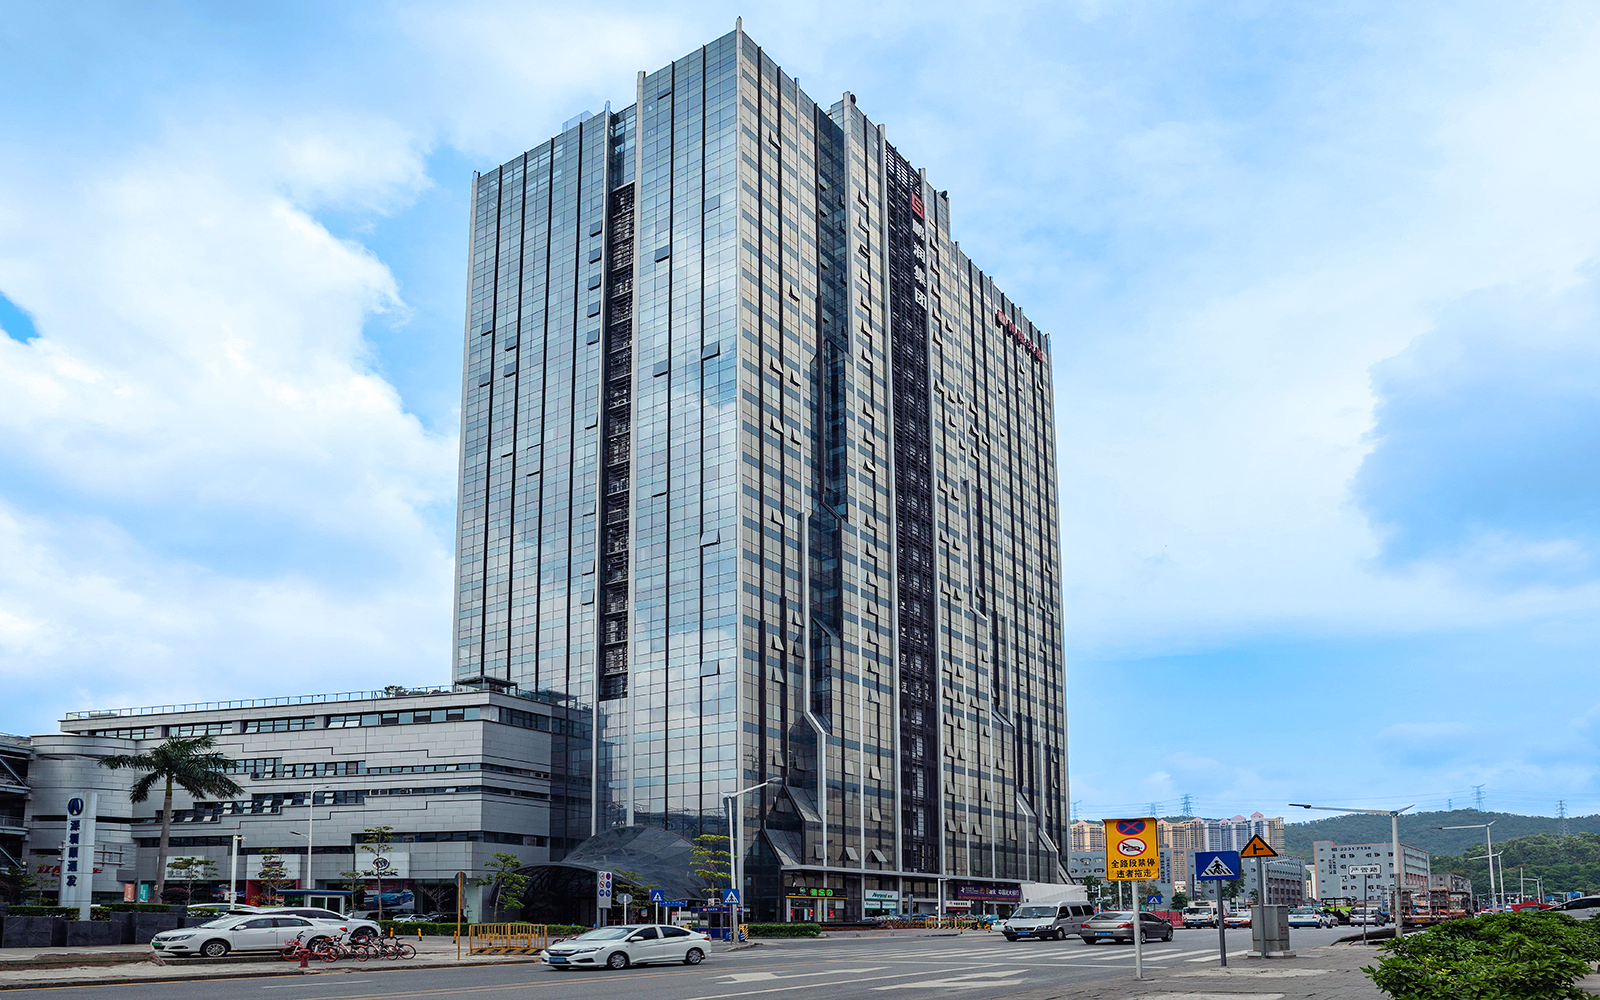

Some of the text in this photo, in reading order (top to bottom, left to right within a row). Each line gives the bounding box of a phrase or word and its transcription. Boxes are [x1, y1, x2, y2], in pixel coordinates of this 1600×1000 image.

[1111, 858, 1155, 868] 全路段禁停
[1116, 869, 1152, 878] 违者拖走
